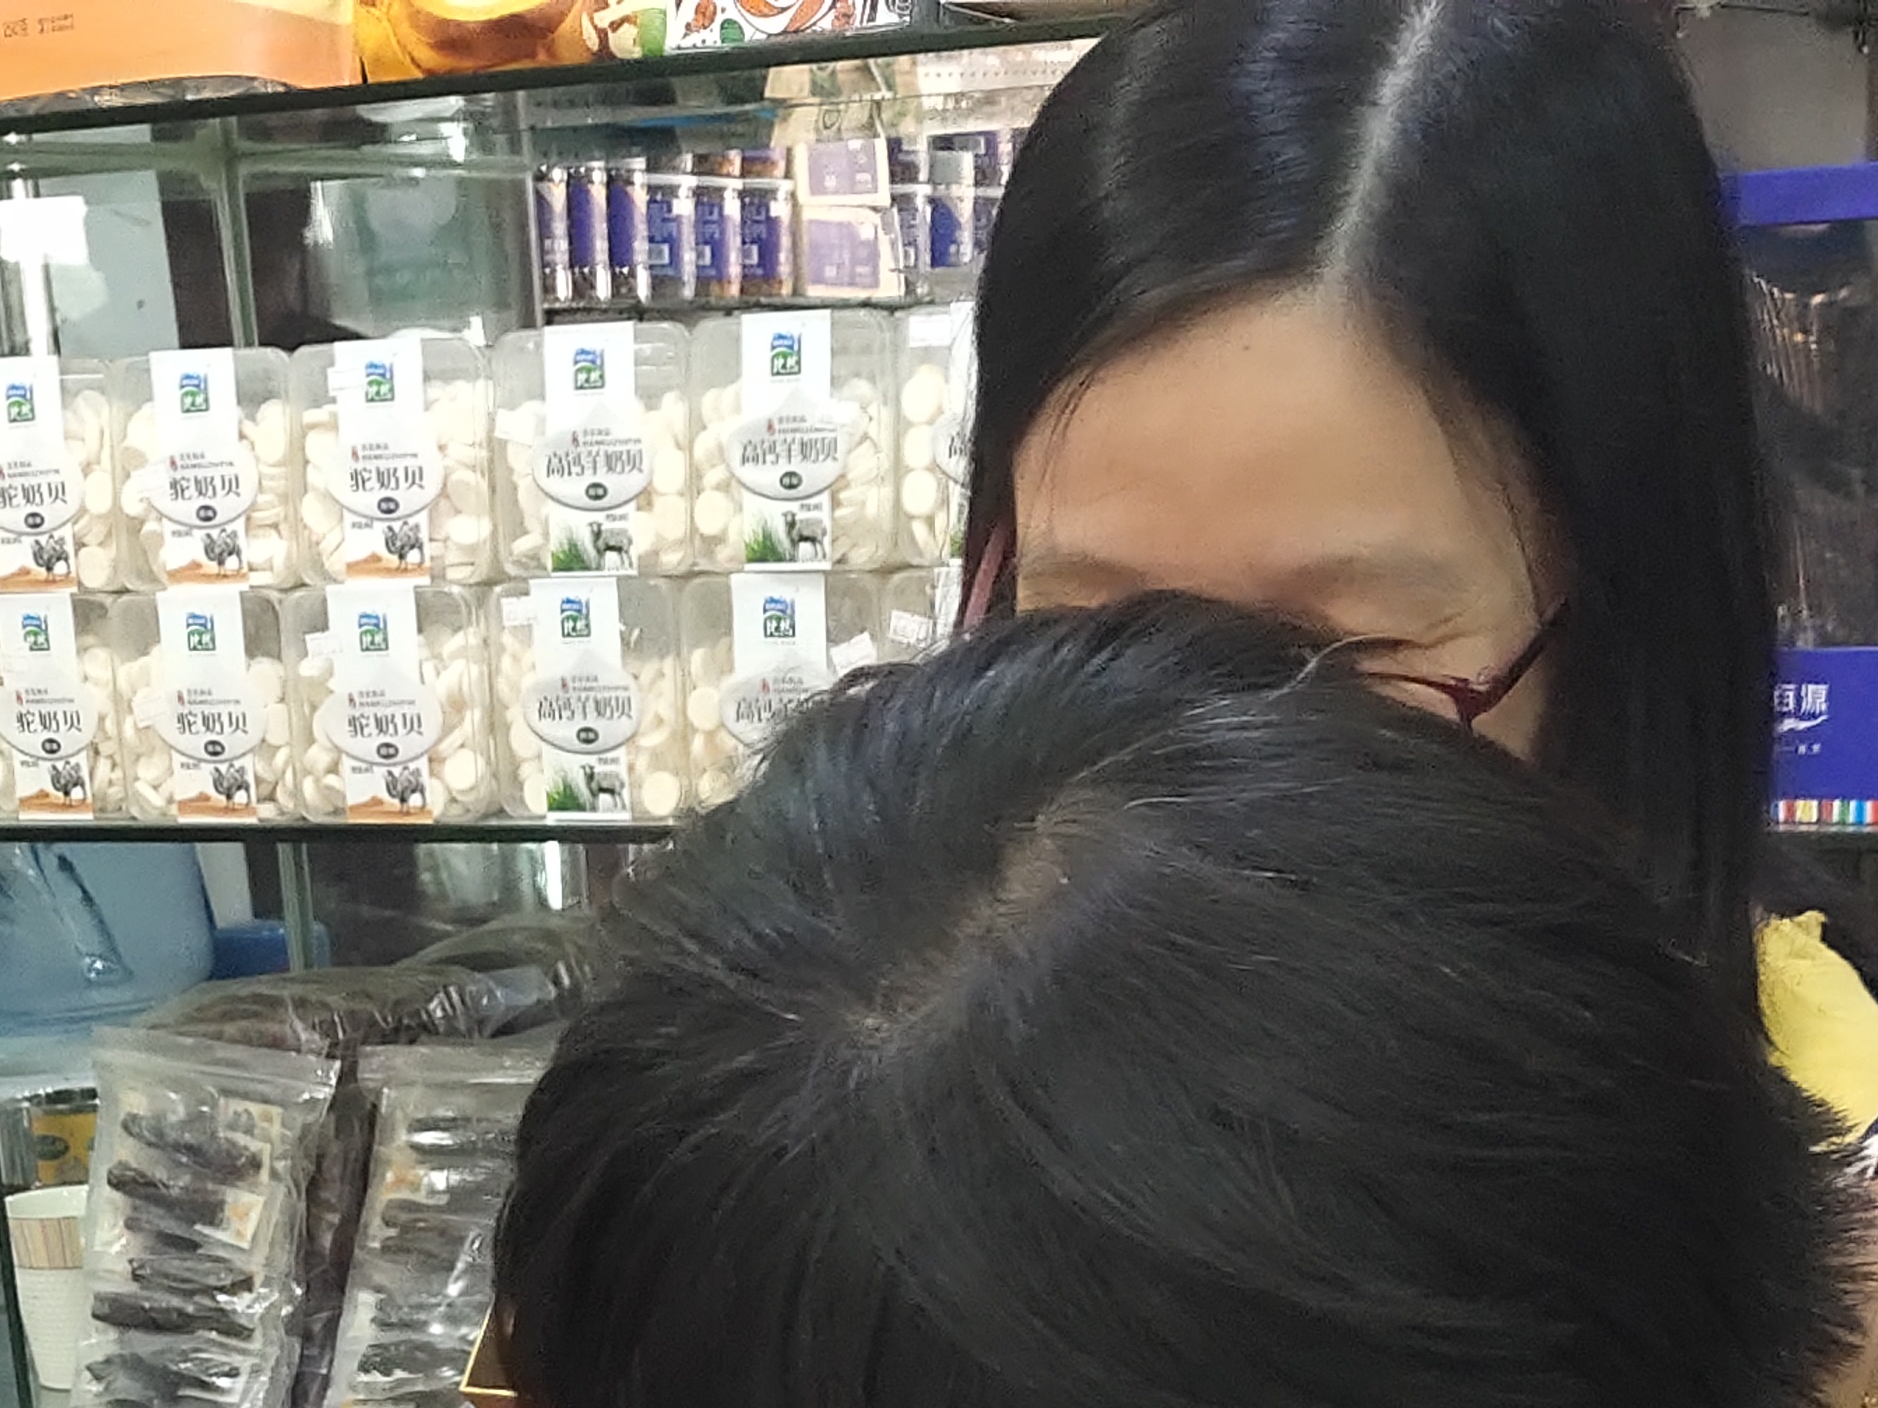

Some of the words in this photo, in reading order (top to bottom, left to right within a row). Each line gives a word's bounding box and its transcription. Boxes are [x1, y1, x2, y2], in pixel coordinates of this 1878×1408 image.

[545, 450, 643, 479] 高钙羊奶贝
[740, 436, 839, 467] 高钙羊奶贝
[169, 471, 241, 502] 驼奶贝
[350, 464, 425, 493] 驼奶贝
[15, 707, 83, 734] 驼奶贝
[176, 707, 249, 736] 驼奶贝
[536, 693, 634, 722] 高钙羊奶贝
[348, 709, 423, 738] 驼奶贝
